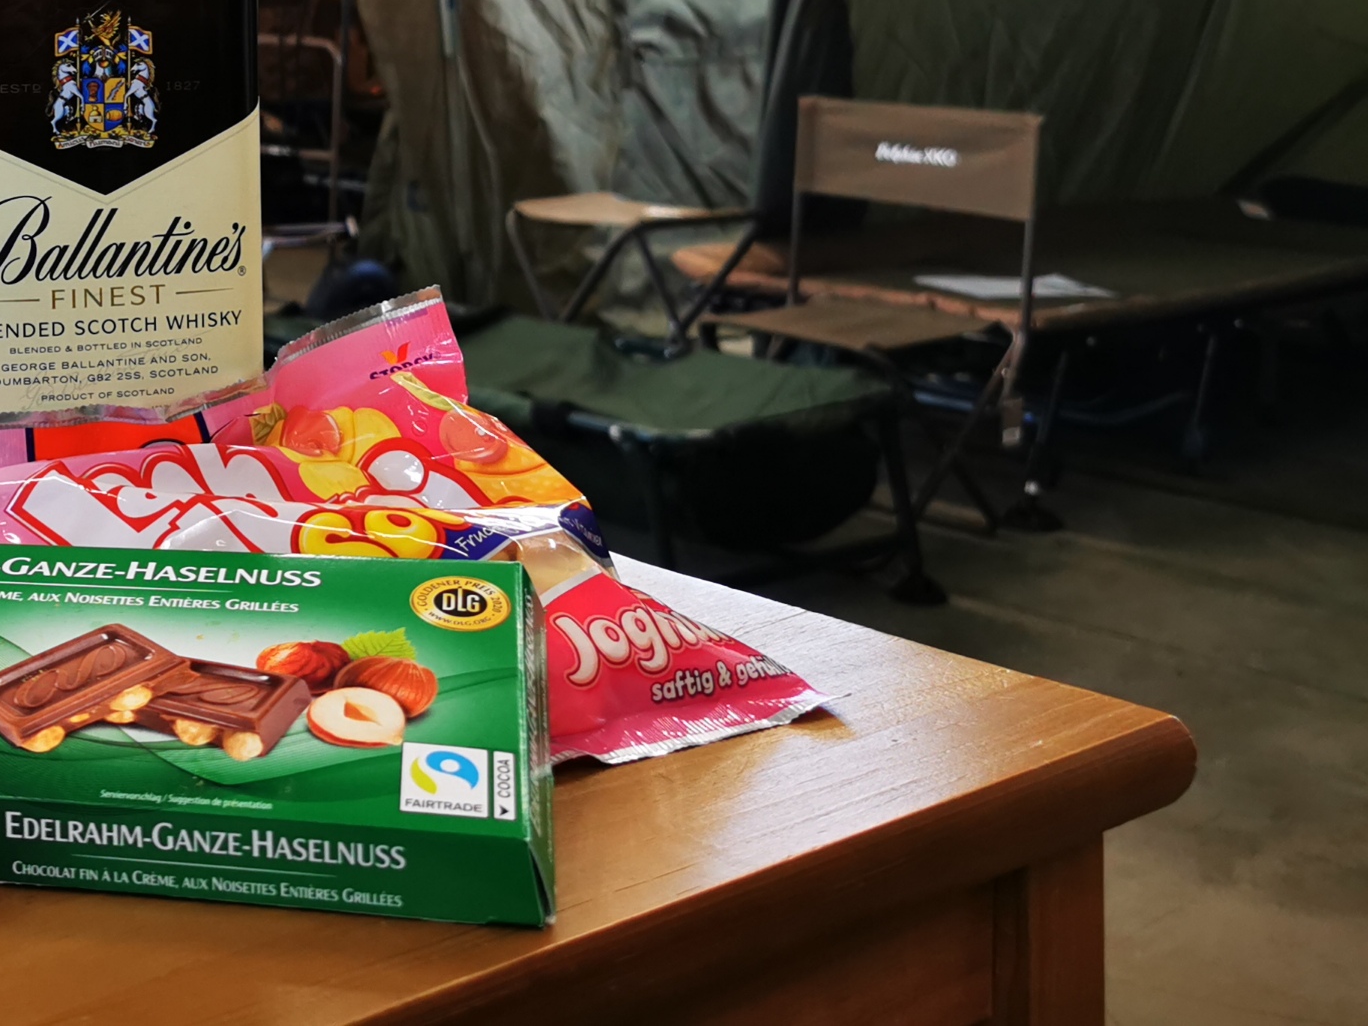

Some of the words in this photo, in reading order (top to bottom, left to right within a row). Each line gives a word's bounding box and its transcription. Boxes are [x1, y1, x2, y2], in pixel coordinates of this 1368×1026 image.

[51, 284, 166, 309] FINEST
[74, 316, 157, 336] SCOTCH
[166, 309, 242, 331] WHISKY
[9, 346, 61, 355] BLENDED
[64, 345, 73, 353] &
[77, 342, 127, 352] BOTTLED
[131, 341, 142, 349] IN
[145, 337, 203, 349] SCOTLAND
[1, 362, 56, 373] GEORGE
[61, 357, 145, 370] BALLANTINE
[150, 353, 177, 364] AND
[181, 352, 212, 362] SON,
[87, 372, 112, 383] G82
[149, 365, 219, 379] SCOTLAND
[41, 392, 93, 402] PRODUCT
[98, 391, 113, 399] OF
[117, 387, 175, 398] SCOTLAND
[28, 590, 61, 604] AUX
[64, 591, 145, 609] NOISETTES
[148, 593, 222, 610] ENTIÈRES
[225, 595, 300, 613] GRILLÉES
[417, 579, 461, 607] GOLDENER
[464, 580, 496, 595] PREIS
[490, 595, 504, 613] 2020
[442, 586, 481, 613] DLG
[652, 668, 715, 702] saftig
[717, 660, 732, 687] &
[496, 758, 511, 799] COCOA
[404, 798, 483, 814] FAIRTRADE
[5, 810, 407, 870] EDELRAHM-GANZE-HASELNUSS
[12, 860, 76, 880] CHOCOLAT
[78, 867, 99, 880] FIN
[114, 870, 130, 883] LA
[182, 875, 208, 891] AUX
[211, 876, 277, 897] NOISETTES
[280, 881, 338, 902] ENTIÈRES
[342, 886, 403, 908] GRILLÉES
